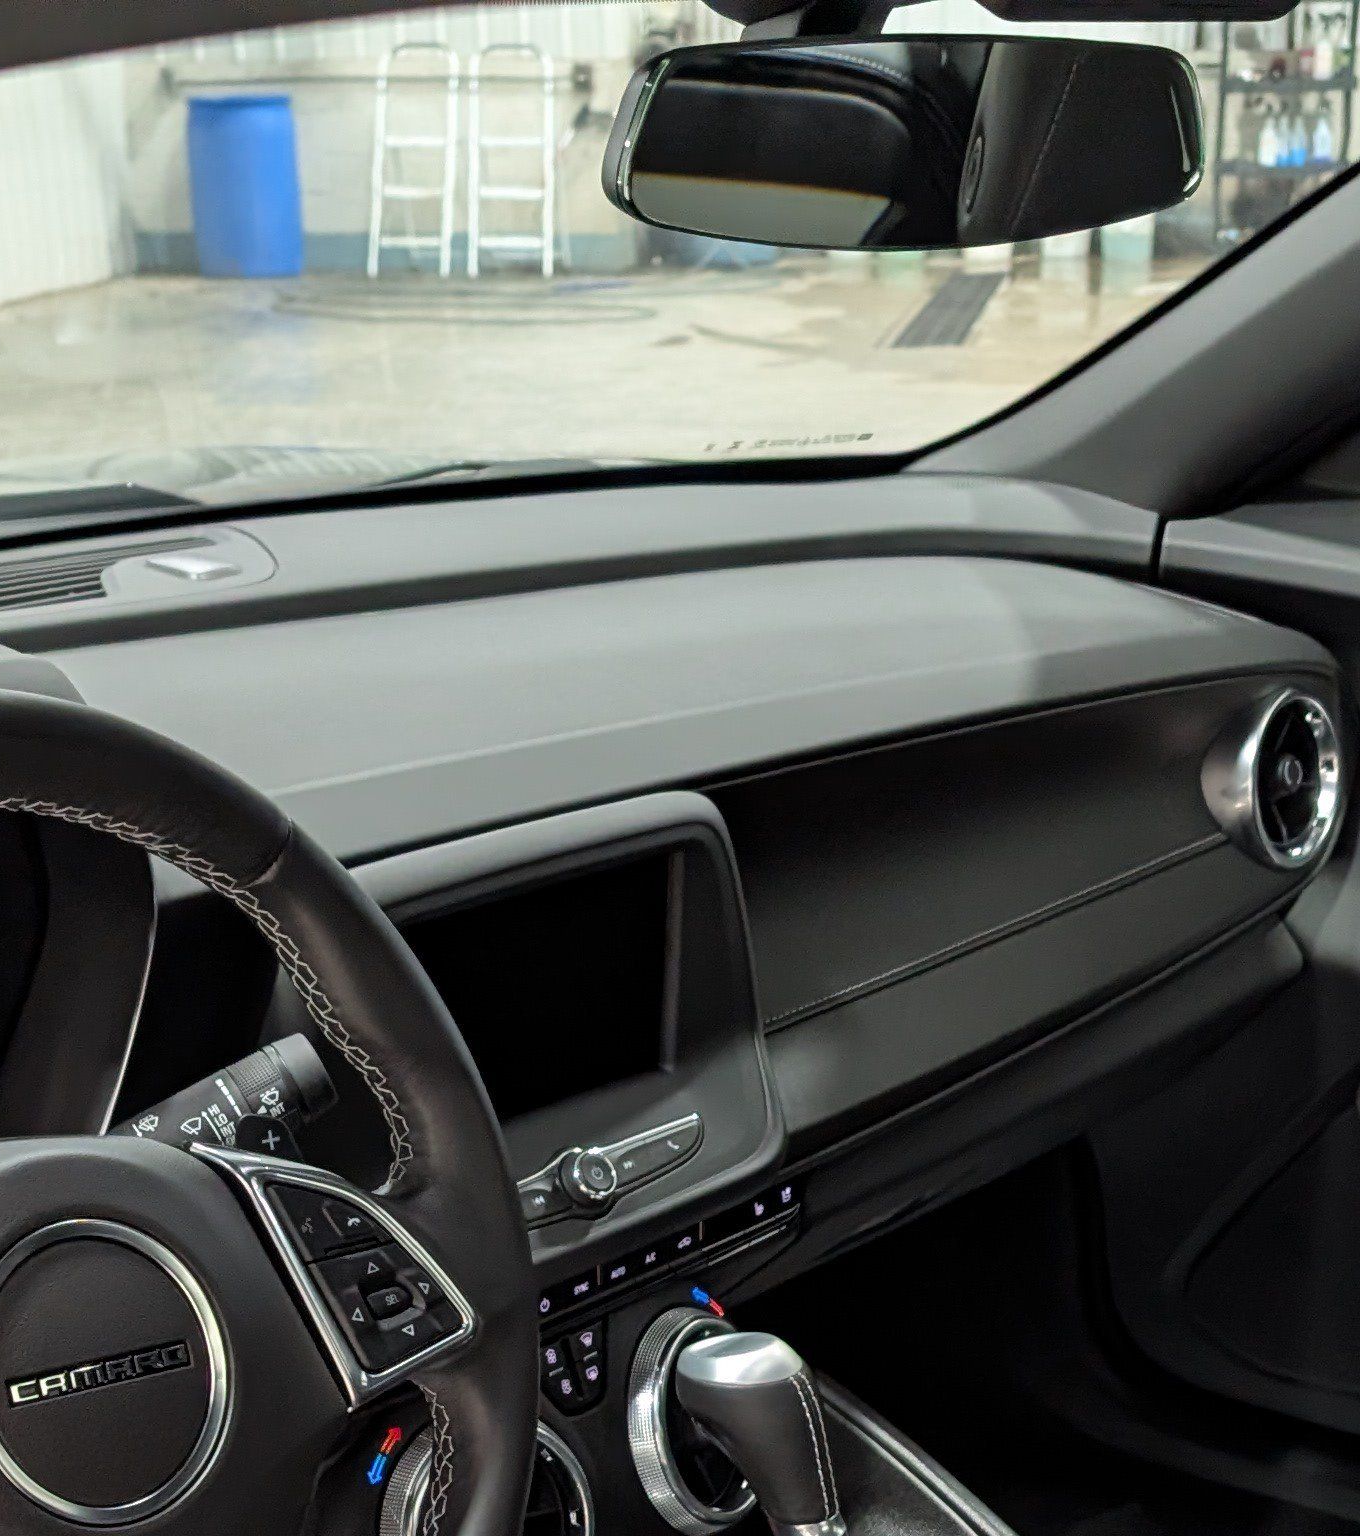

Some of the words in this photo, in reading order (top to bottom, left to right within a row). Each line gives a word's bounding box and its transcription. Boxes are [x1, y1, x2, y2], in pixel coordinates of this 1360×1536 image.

[207, 1104, 221, 1117] HI
[269, 1101, 286, 1118] INT
[215, 1113, 228, 1128] LO
[9, 1343, 189, 1404] CAMARO
